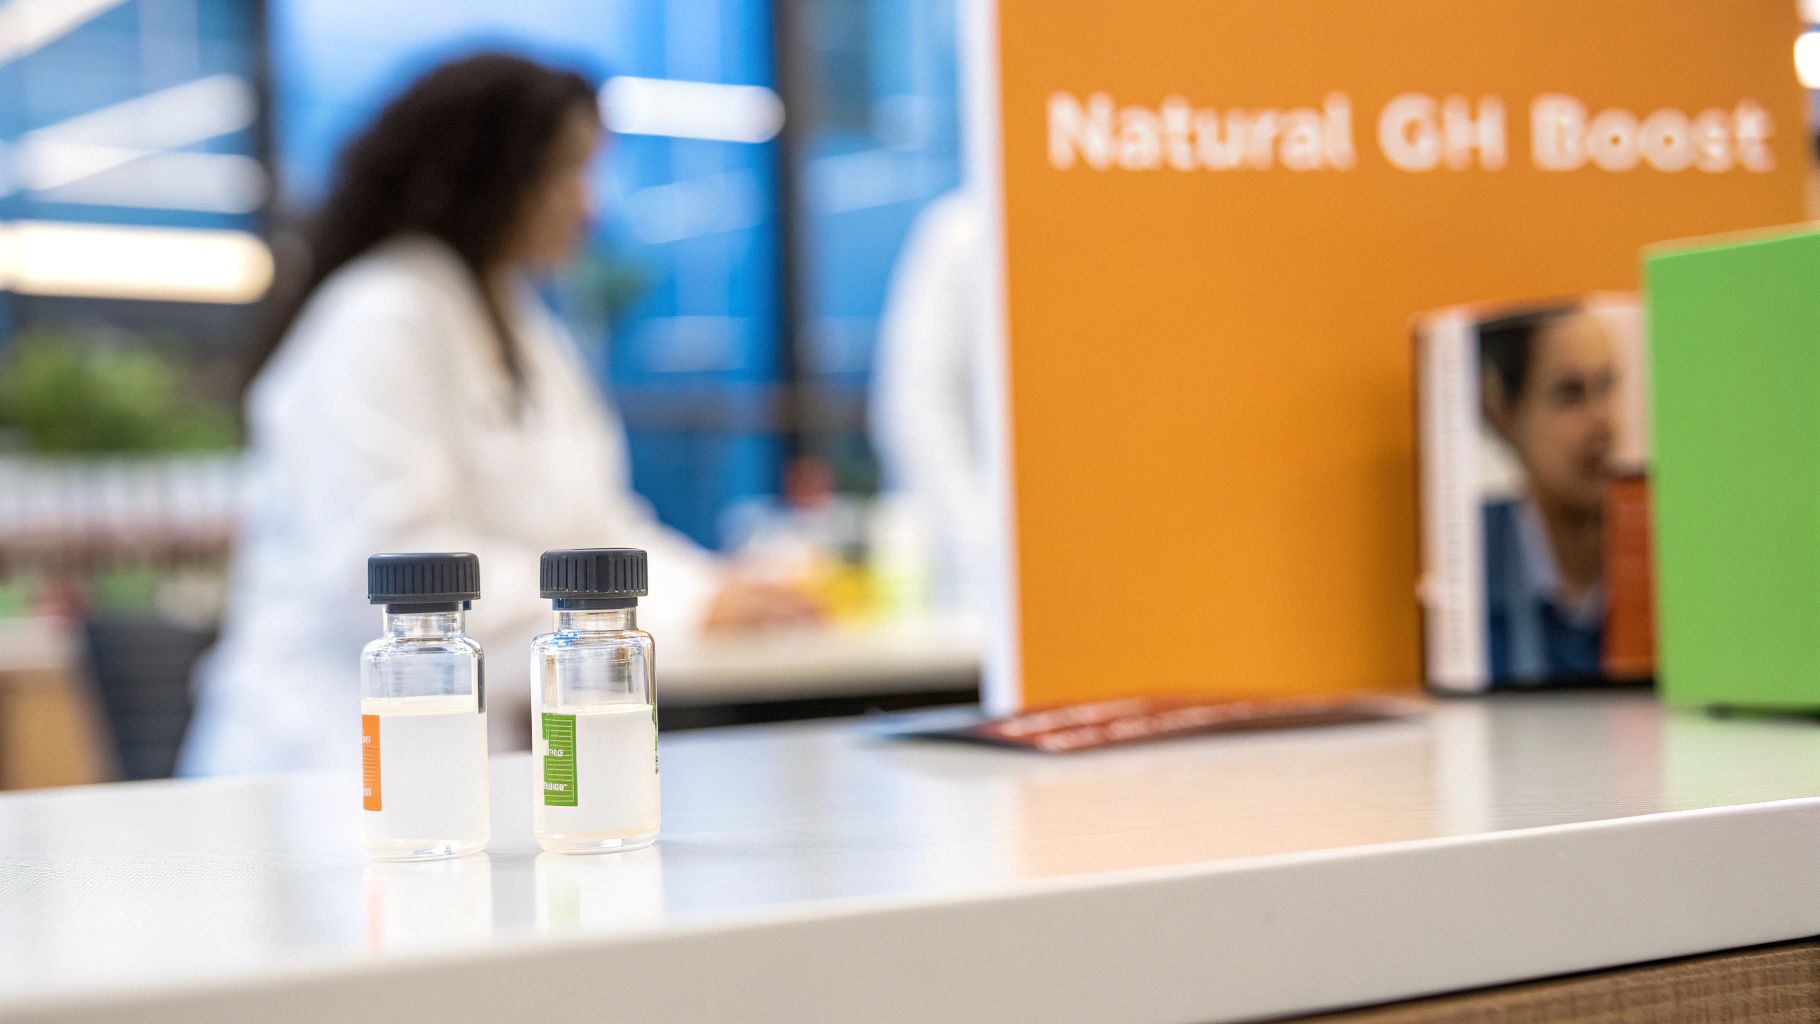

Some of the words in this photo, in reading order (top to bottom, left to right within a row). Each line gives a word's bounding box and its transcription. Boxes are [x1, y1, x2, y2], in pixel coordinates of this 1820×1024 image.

[1047, 93, 1355, 171] Natural
[1379, 93, 1506, 171] GH
[1531, 94, 1774, 172] Boost
